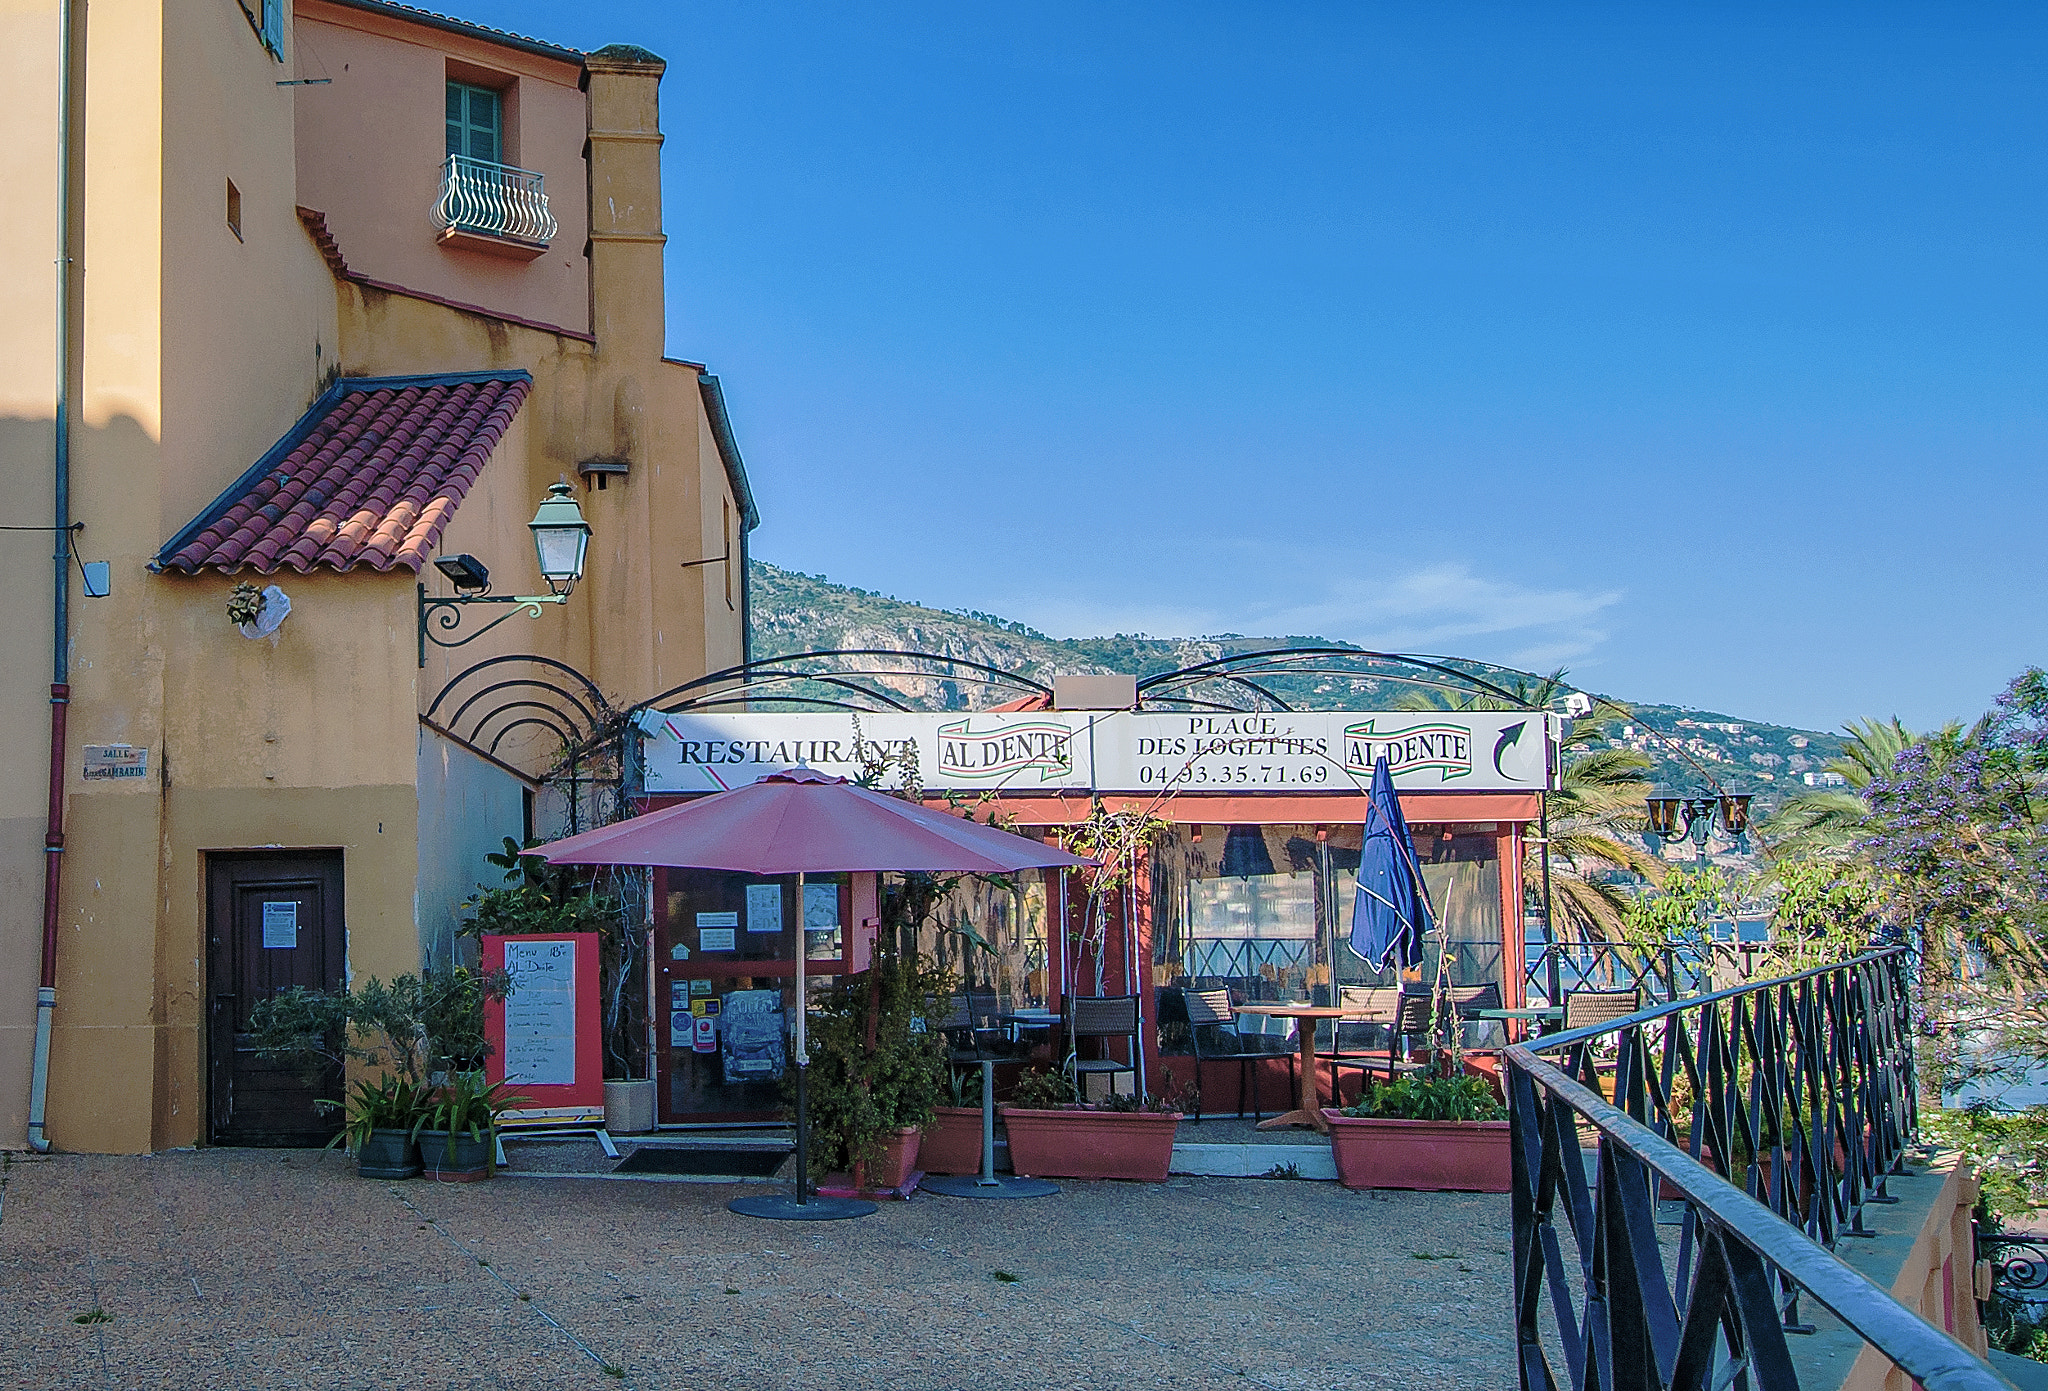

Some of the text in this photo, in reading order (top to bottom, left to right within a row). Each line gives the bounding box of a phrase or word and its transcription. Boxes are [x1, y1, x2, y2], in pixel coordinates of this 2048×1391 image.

[1187, 717, 1277, 735] PLACE
[102, 749, 130, 759] SALLE
[943, 732, 1067, 768] AL DENTE
[1137, 737, 1329, 757] DES LOGETTES
[1349, 733, 1468, 767] AL DENTE
[1139, 764, 1328, 784] 04.93.35.71.69
[508, 943, 538, 959] Menu
